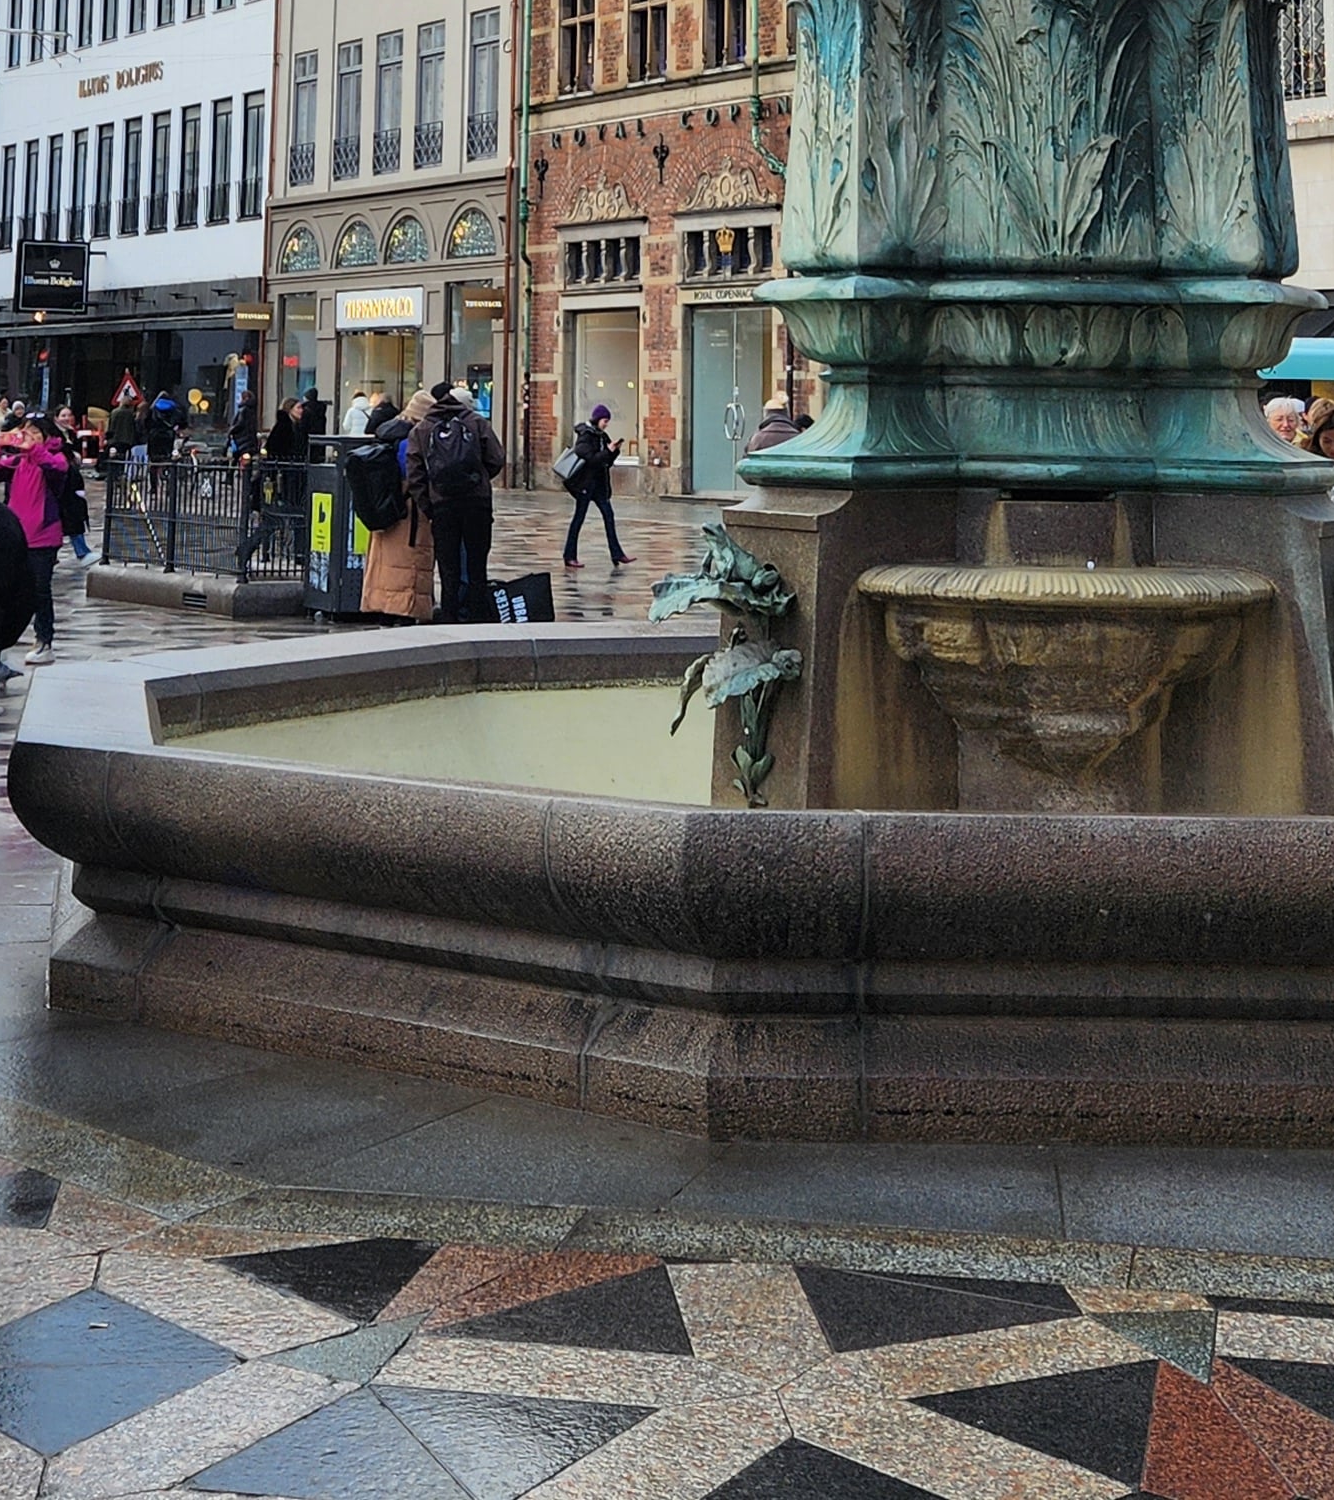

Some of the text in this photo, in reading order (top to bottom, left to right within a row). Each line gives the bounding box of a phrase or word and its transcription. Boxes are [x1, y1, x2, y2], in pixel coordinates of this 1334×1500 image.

[116, 60, 164, 90] BOLIGHUS
[550, 118, 646, 149] ROYAL
[693, 290, 714, 301] ROYAL
